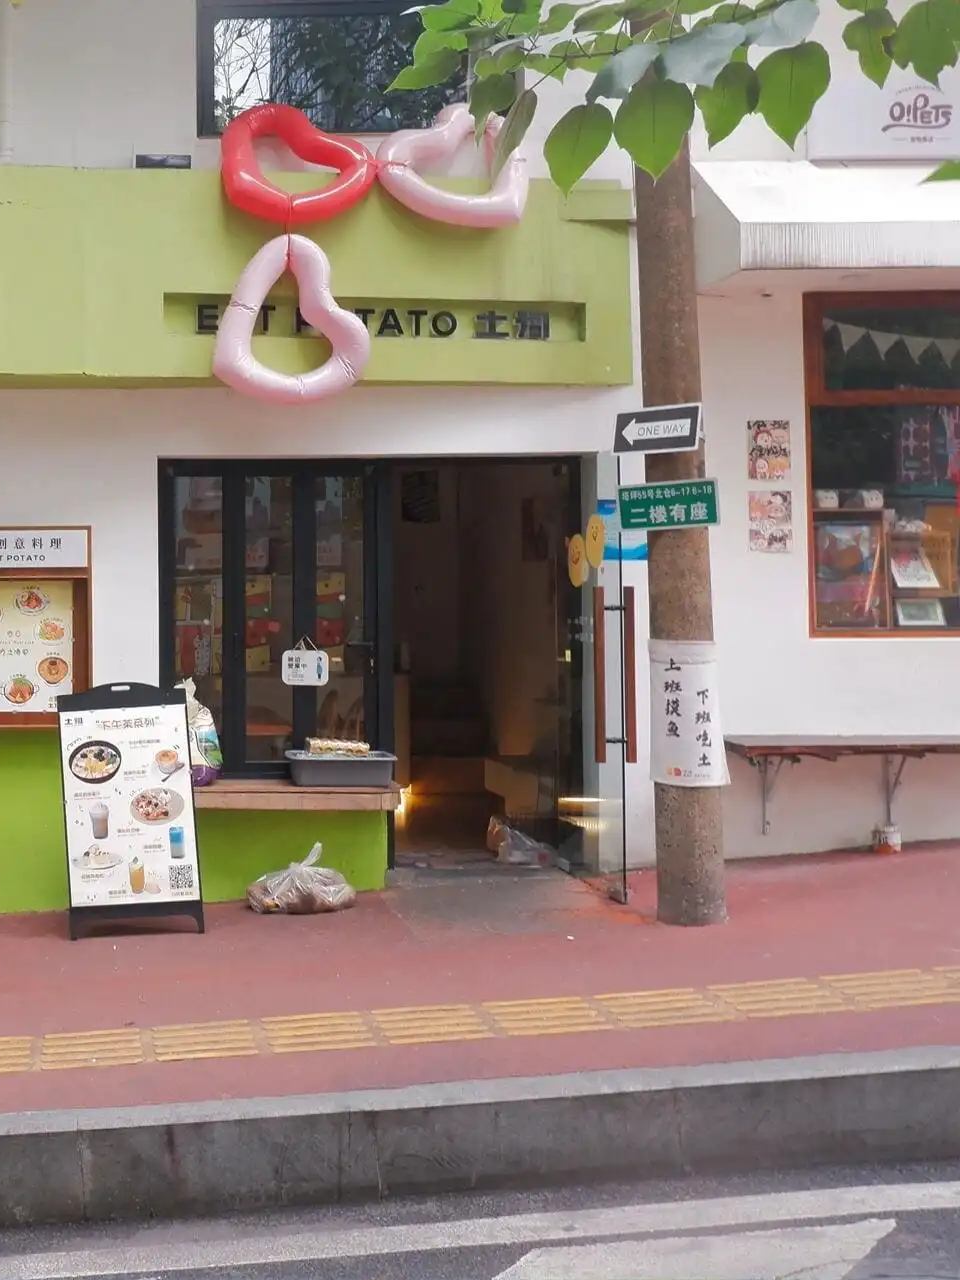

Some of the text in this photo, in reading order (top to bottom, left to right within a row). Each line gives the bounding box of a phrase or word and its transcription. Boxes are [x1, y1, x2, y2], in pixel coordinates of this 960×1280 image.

[197, 304, 276, 332] ET
[295, 306, 458, 338] PTATO
[637, 423, 686, 437] ONE WAY
[630, 501, 708, 523] 二楼有座
[7, 554, 46, 562] POTATO
[664, 658, 682, 738] 上班摸鱼
[695, 688, 712, 767] 下班吃土
